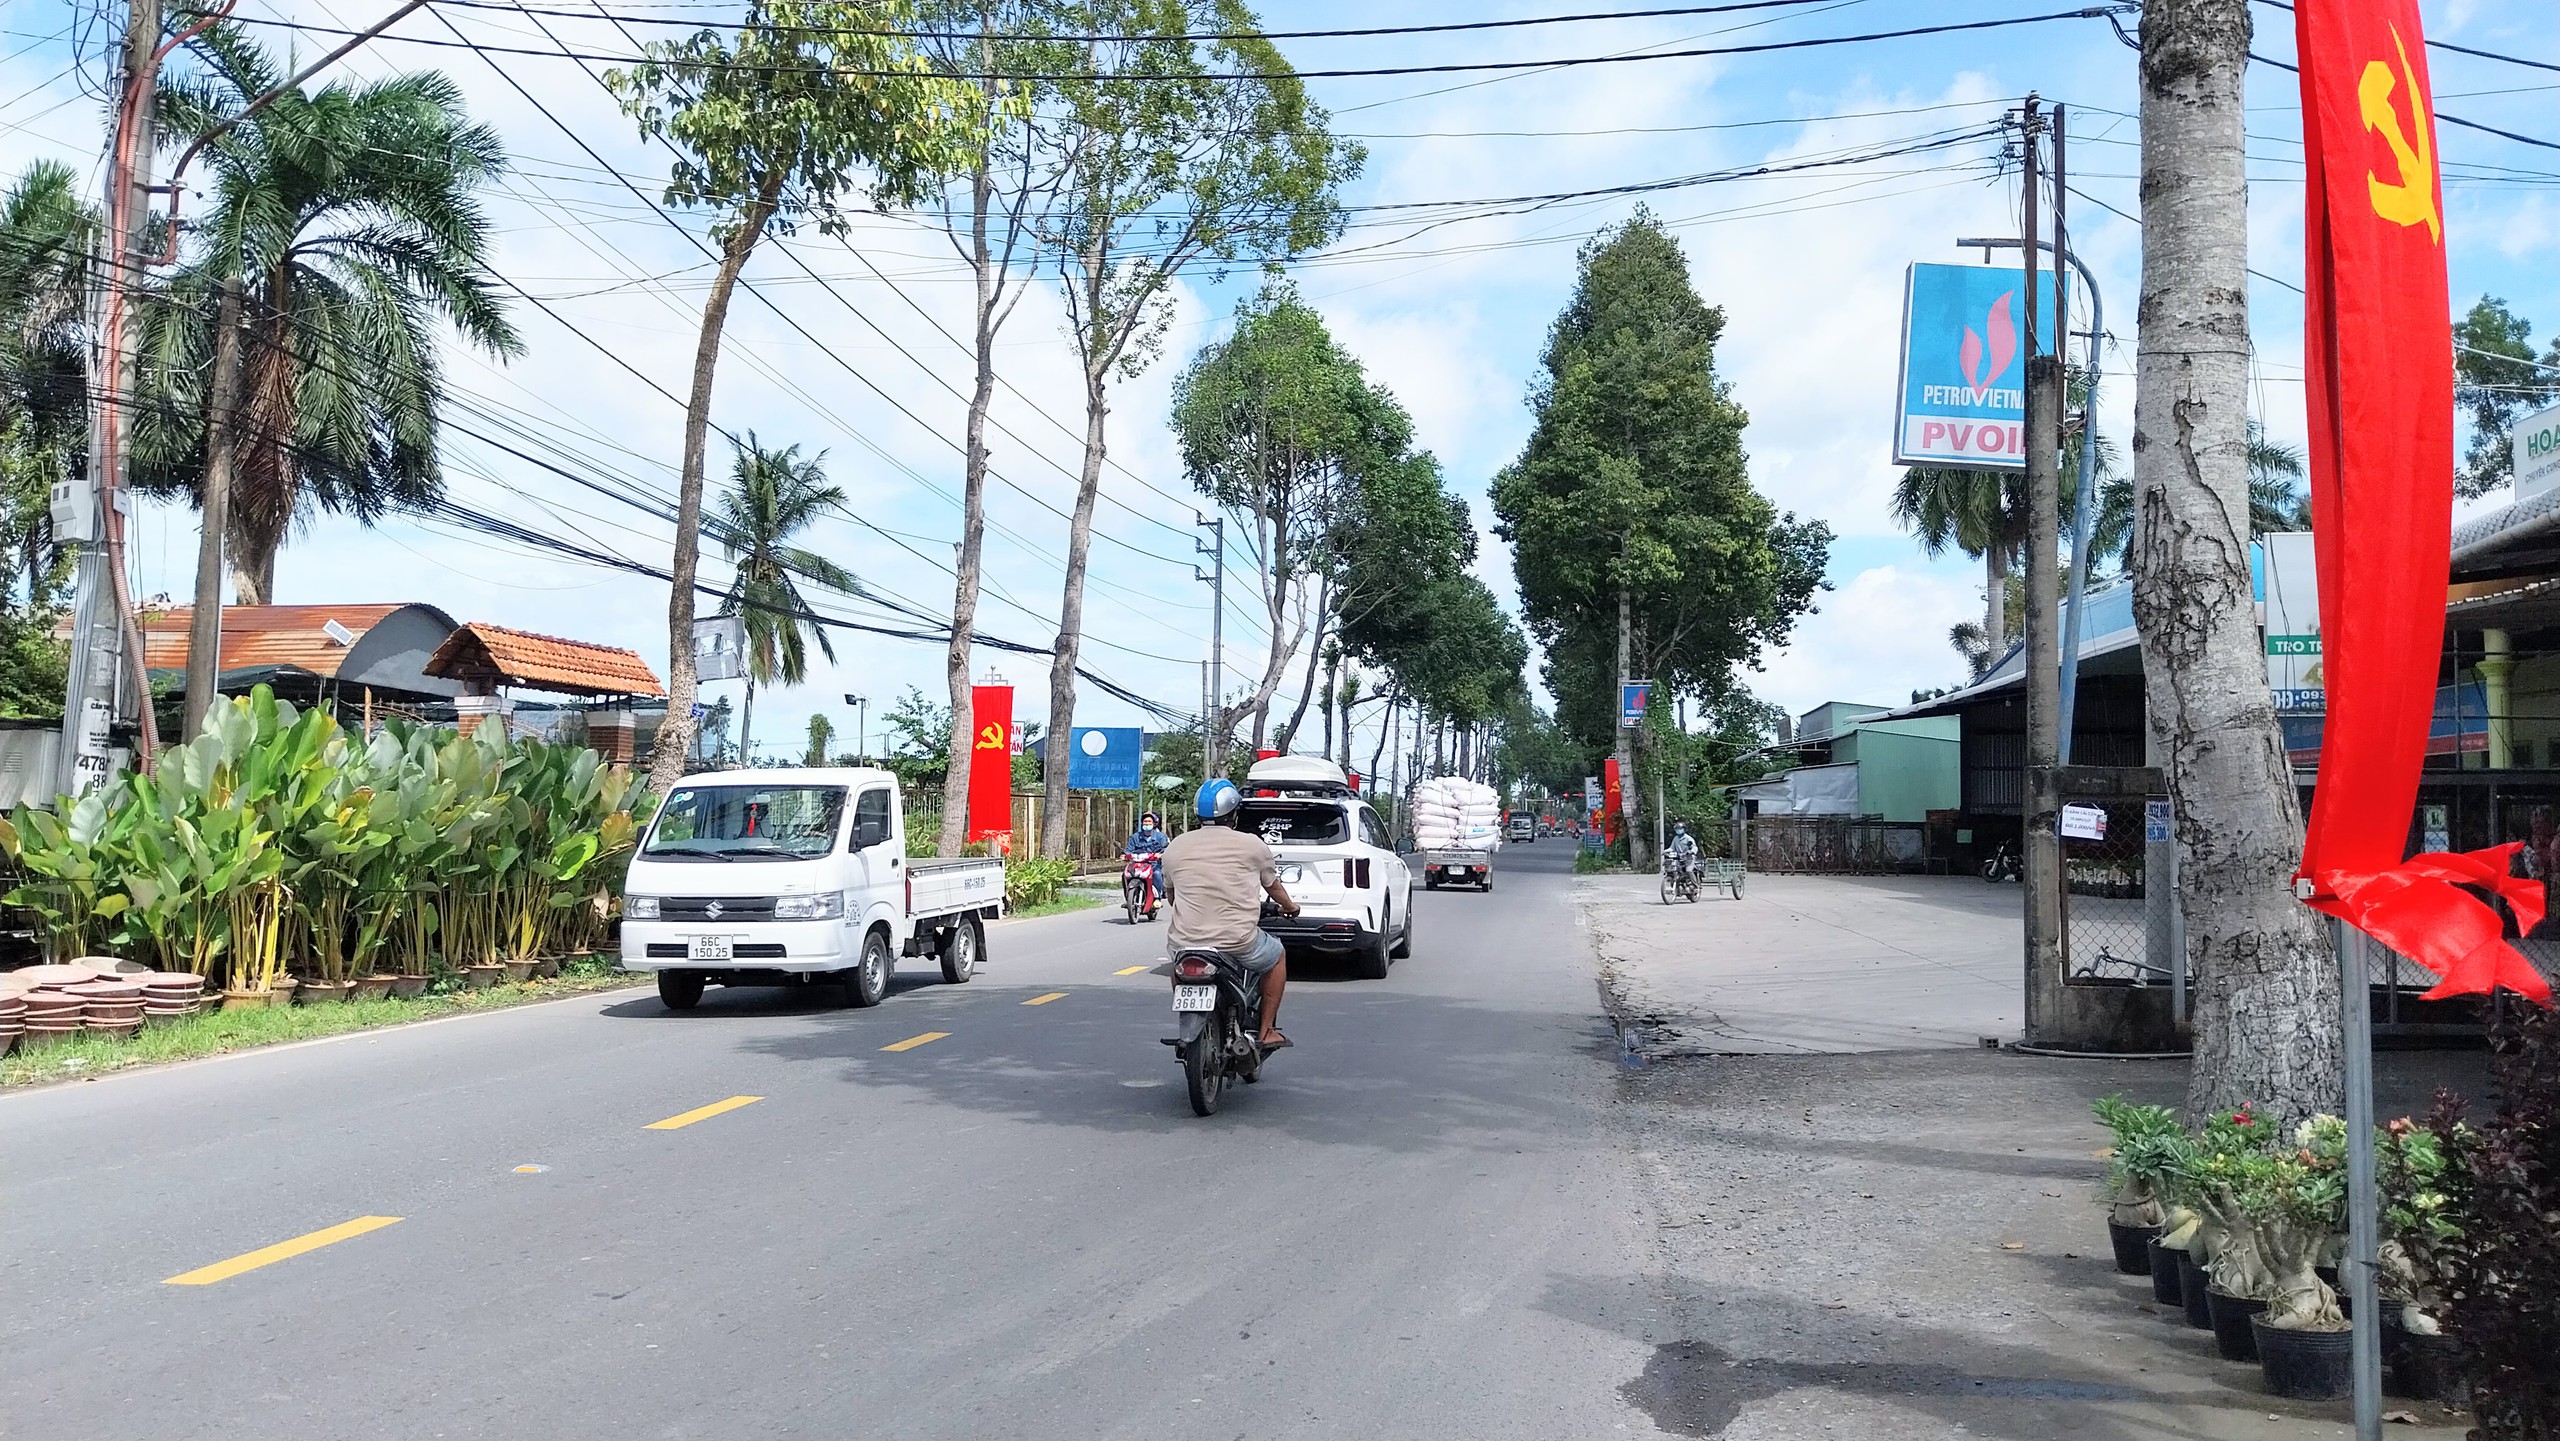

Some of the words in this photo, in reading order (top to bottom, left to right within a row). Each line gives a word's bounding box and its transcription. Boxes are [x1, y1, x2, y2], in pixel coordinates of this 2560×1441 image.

[1923, 385, 2024, 410] PETROVIETN
[1922, 422, 2025, 455] PVOI
[701, 936, 720, 947] 66C
[694, 947, 728, 958] 150.25
[1181, 986, 1209, 997] 66-V1
[1175, 998, 1213, 1009] 368.10
